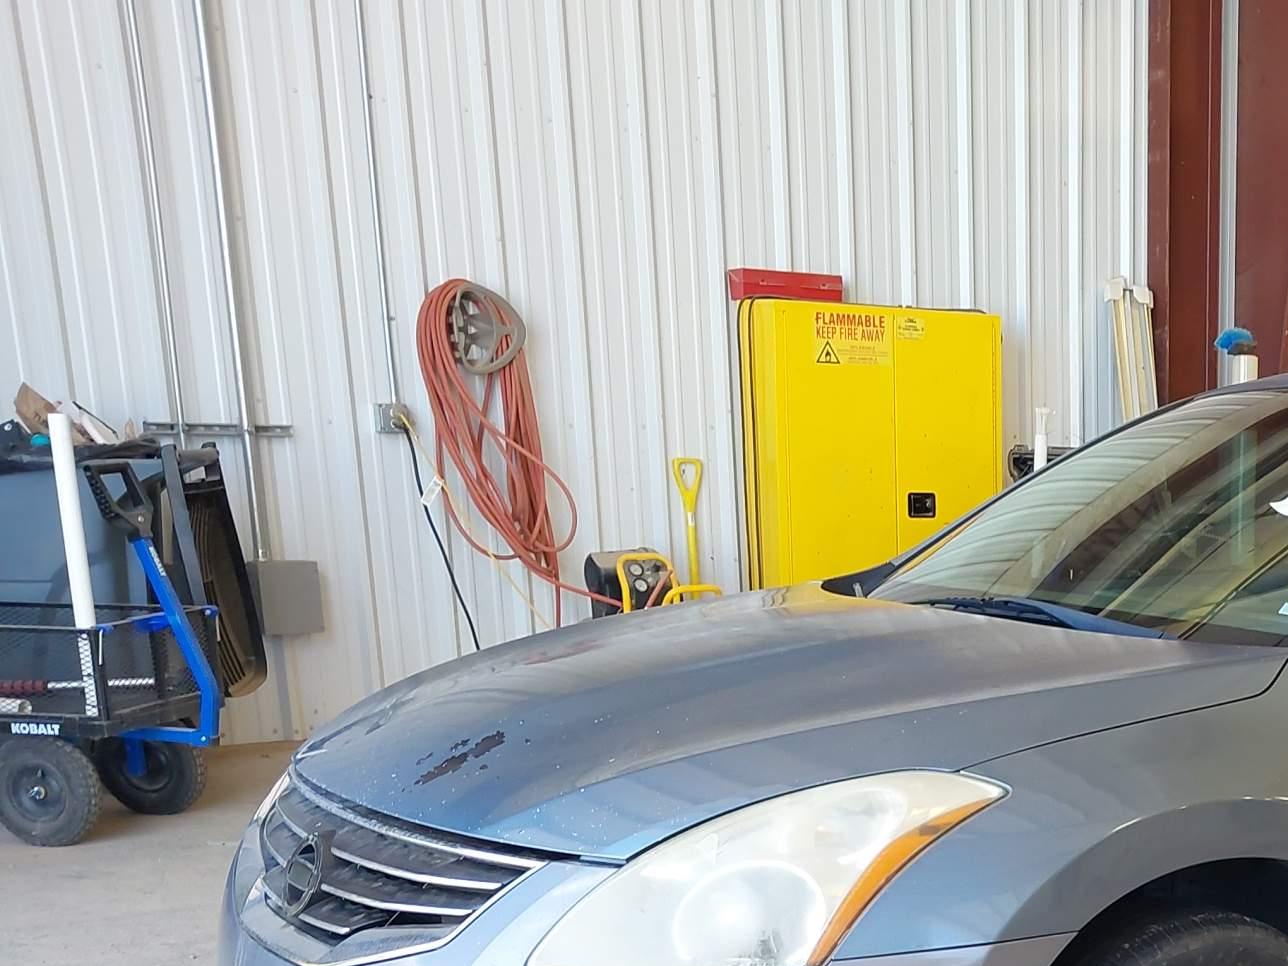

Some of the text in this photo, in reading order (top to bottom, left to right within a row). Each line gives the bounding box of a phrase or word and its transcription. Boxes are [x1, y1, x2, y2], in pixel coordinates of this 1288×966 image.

[815, 312, 885, 329] FLAMMABLE
[816, 326, 837, 340] KEEP
[839, 328, 859, 341] FIRE
[860, 329, 886, 345] AWAY
[11, 722, 60, 736] KOBALT
